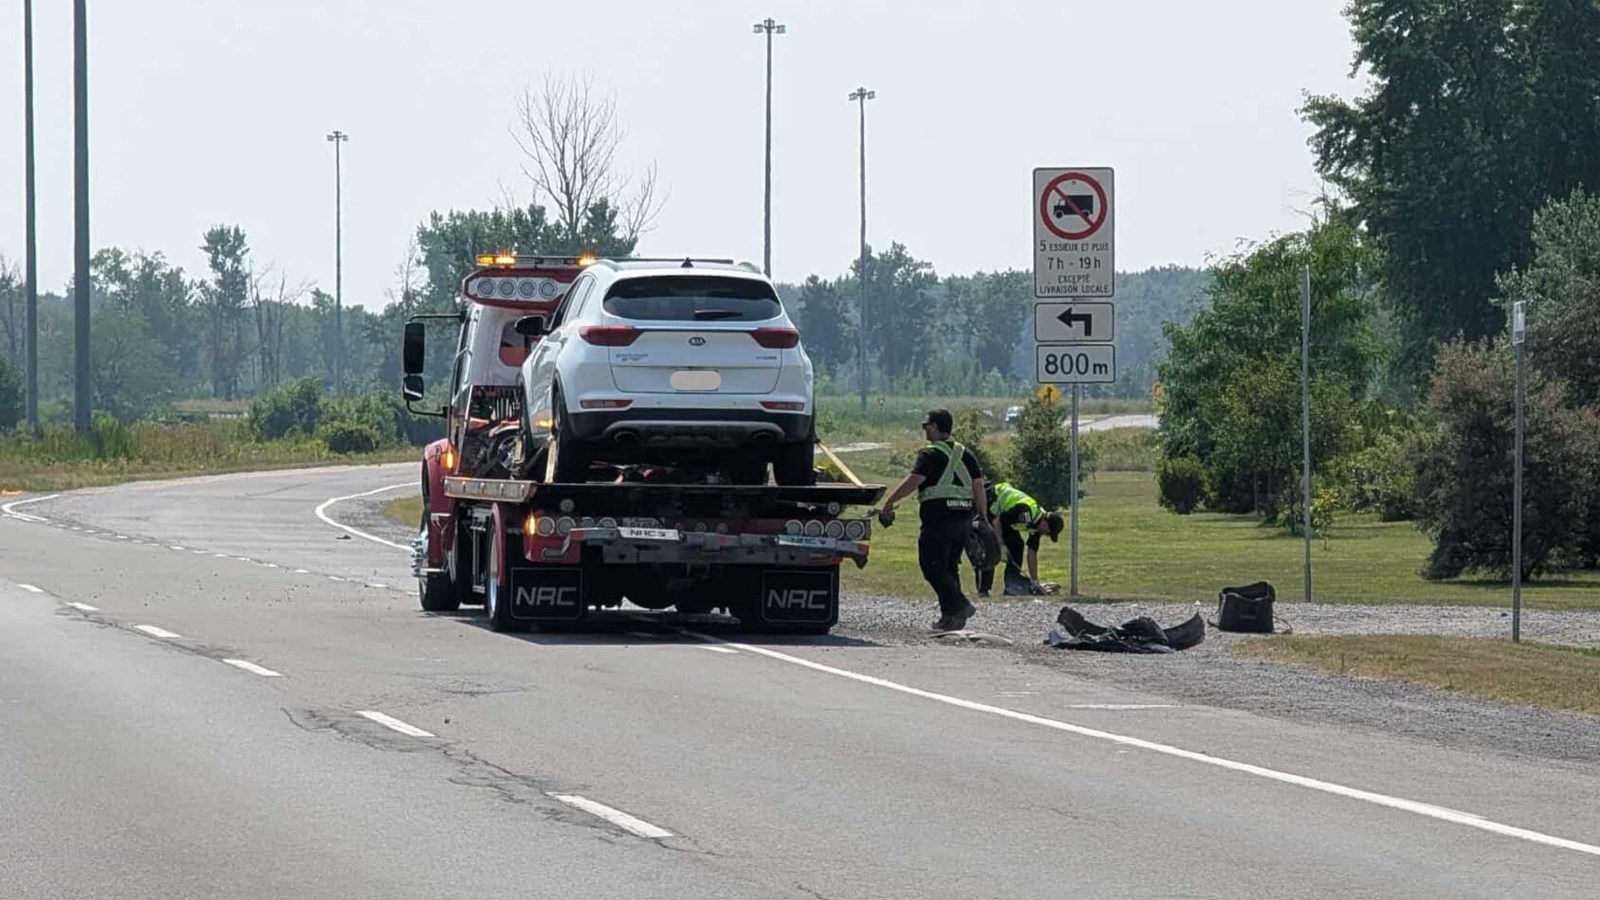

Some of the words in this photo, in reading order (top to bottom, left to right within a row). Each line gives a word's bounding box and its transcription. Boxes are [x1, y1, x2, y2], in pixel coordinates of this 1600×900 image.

[1040, 240, 1046, 252] 5
[1049, 243, 1078, 251] ESSIEUX
[1081, 243, 1089, 251] ET
[1091, 242, 1109, 251] PLUS
[1058, 273, 1090, 283] EXCEPTÉ
[1040, 285, 1078, 294] LIVRAISON
[1081, 284, 1109, 293] LOCALE
[516, 587, 577, 606] NRC
[767, 589, 828, 609] NRC
